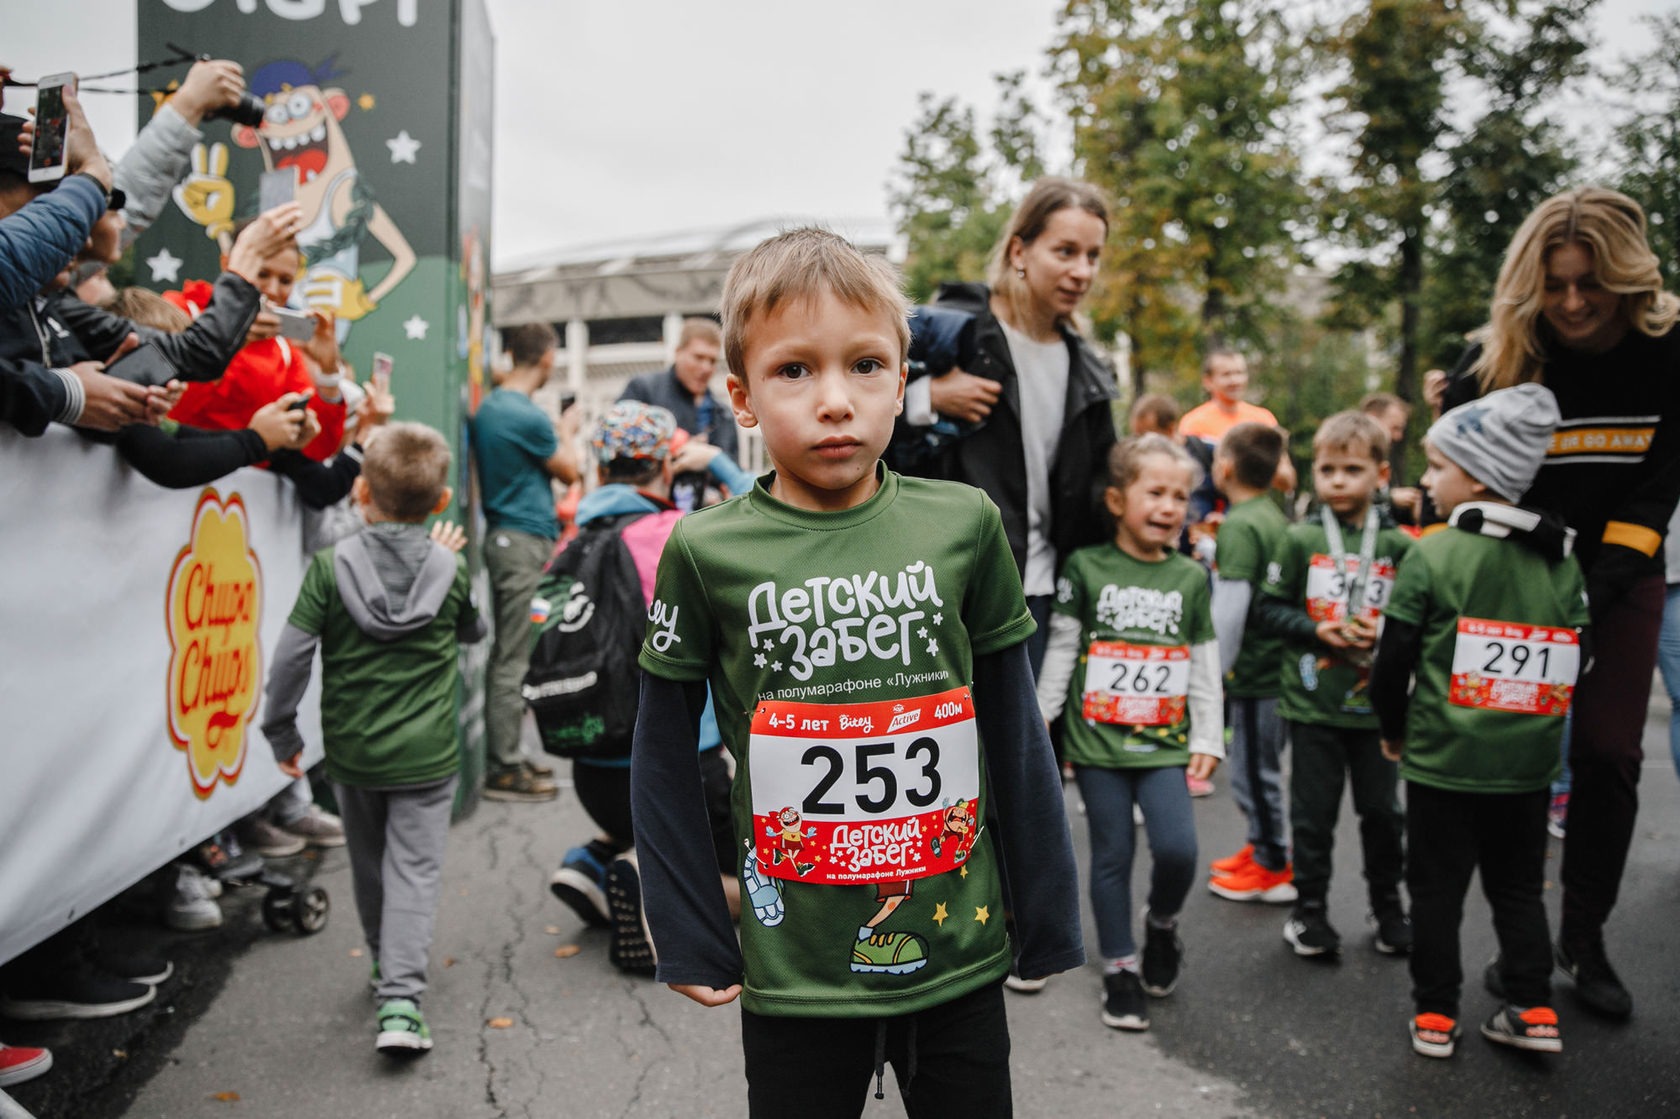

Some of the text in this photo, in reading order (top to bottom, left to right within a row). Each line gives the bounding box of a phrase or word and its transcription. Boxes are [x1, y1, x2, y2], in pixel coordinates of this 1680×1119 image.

[748, 560, 943, 648] Детский
[780, 610, 925, 682] забег
[1483, 641, 1550, 678] 291
[180, 636, 251, 714] Chups
[758, 690, 774, 701] на
[778, 679, 882, 700] полумарафоне
[1110, 663, 1170, 693] 262
[768, 712, 829, 731] 4-5 лет
[840, 715, 874, 733] Bitey
[892, 713, 919, 728] Active
[800, 737, 942, 815] 253
[830, 817, 923, 855] Детский
[846, 841, 914, 873] забег
[838, 870, 894, 881] полумарафоне
[896, 866, 927, 877] Лужники
